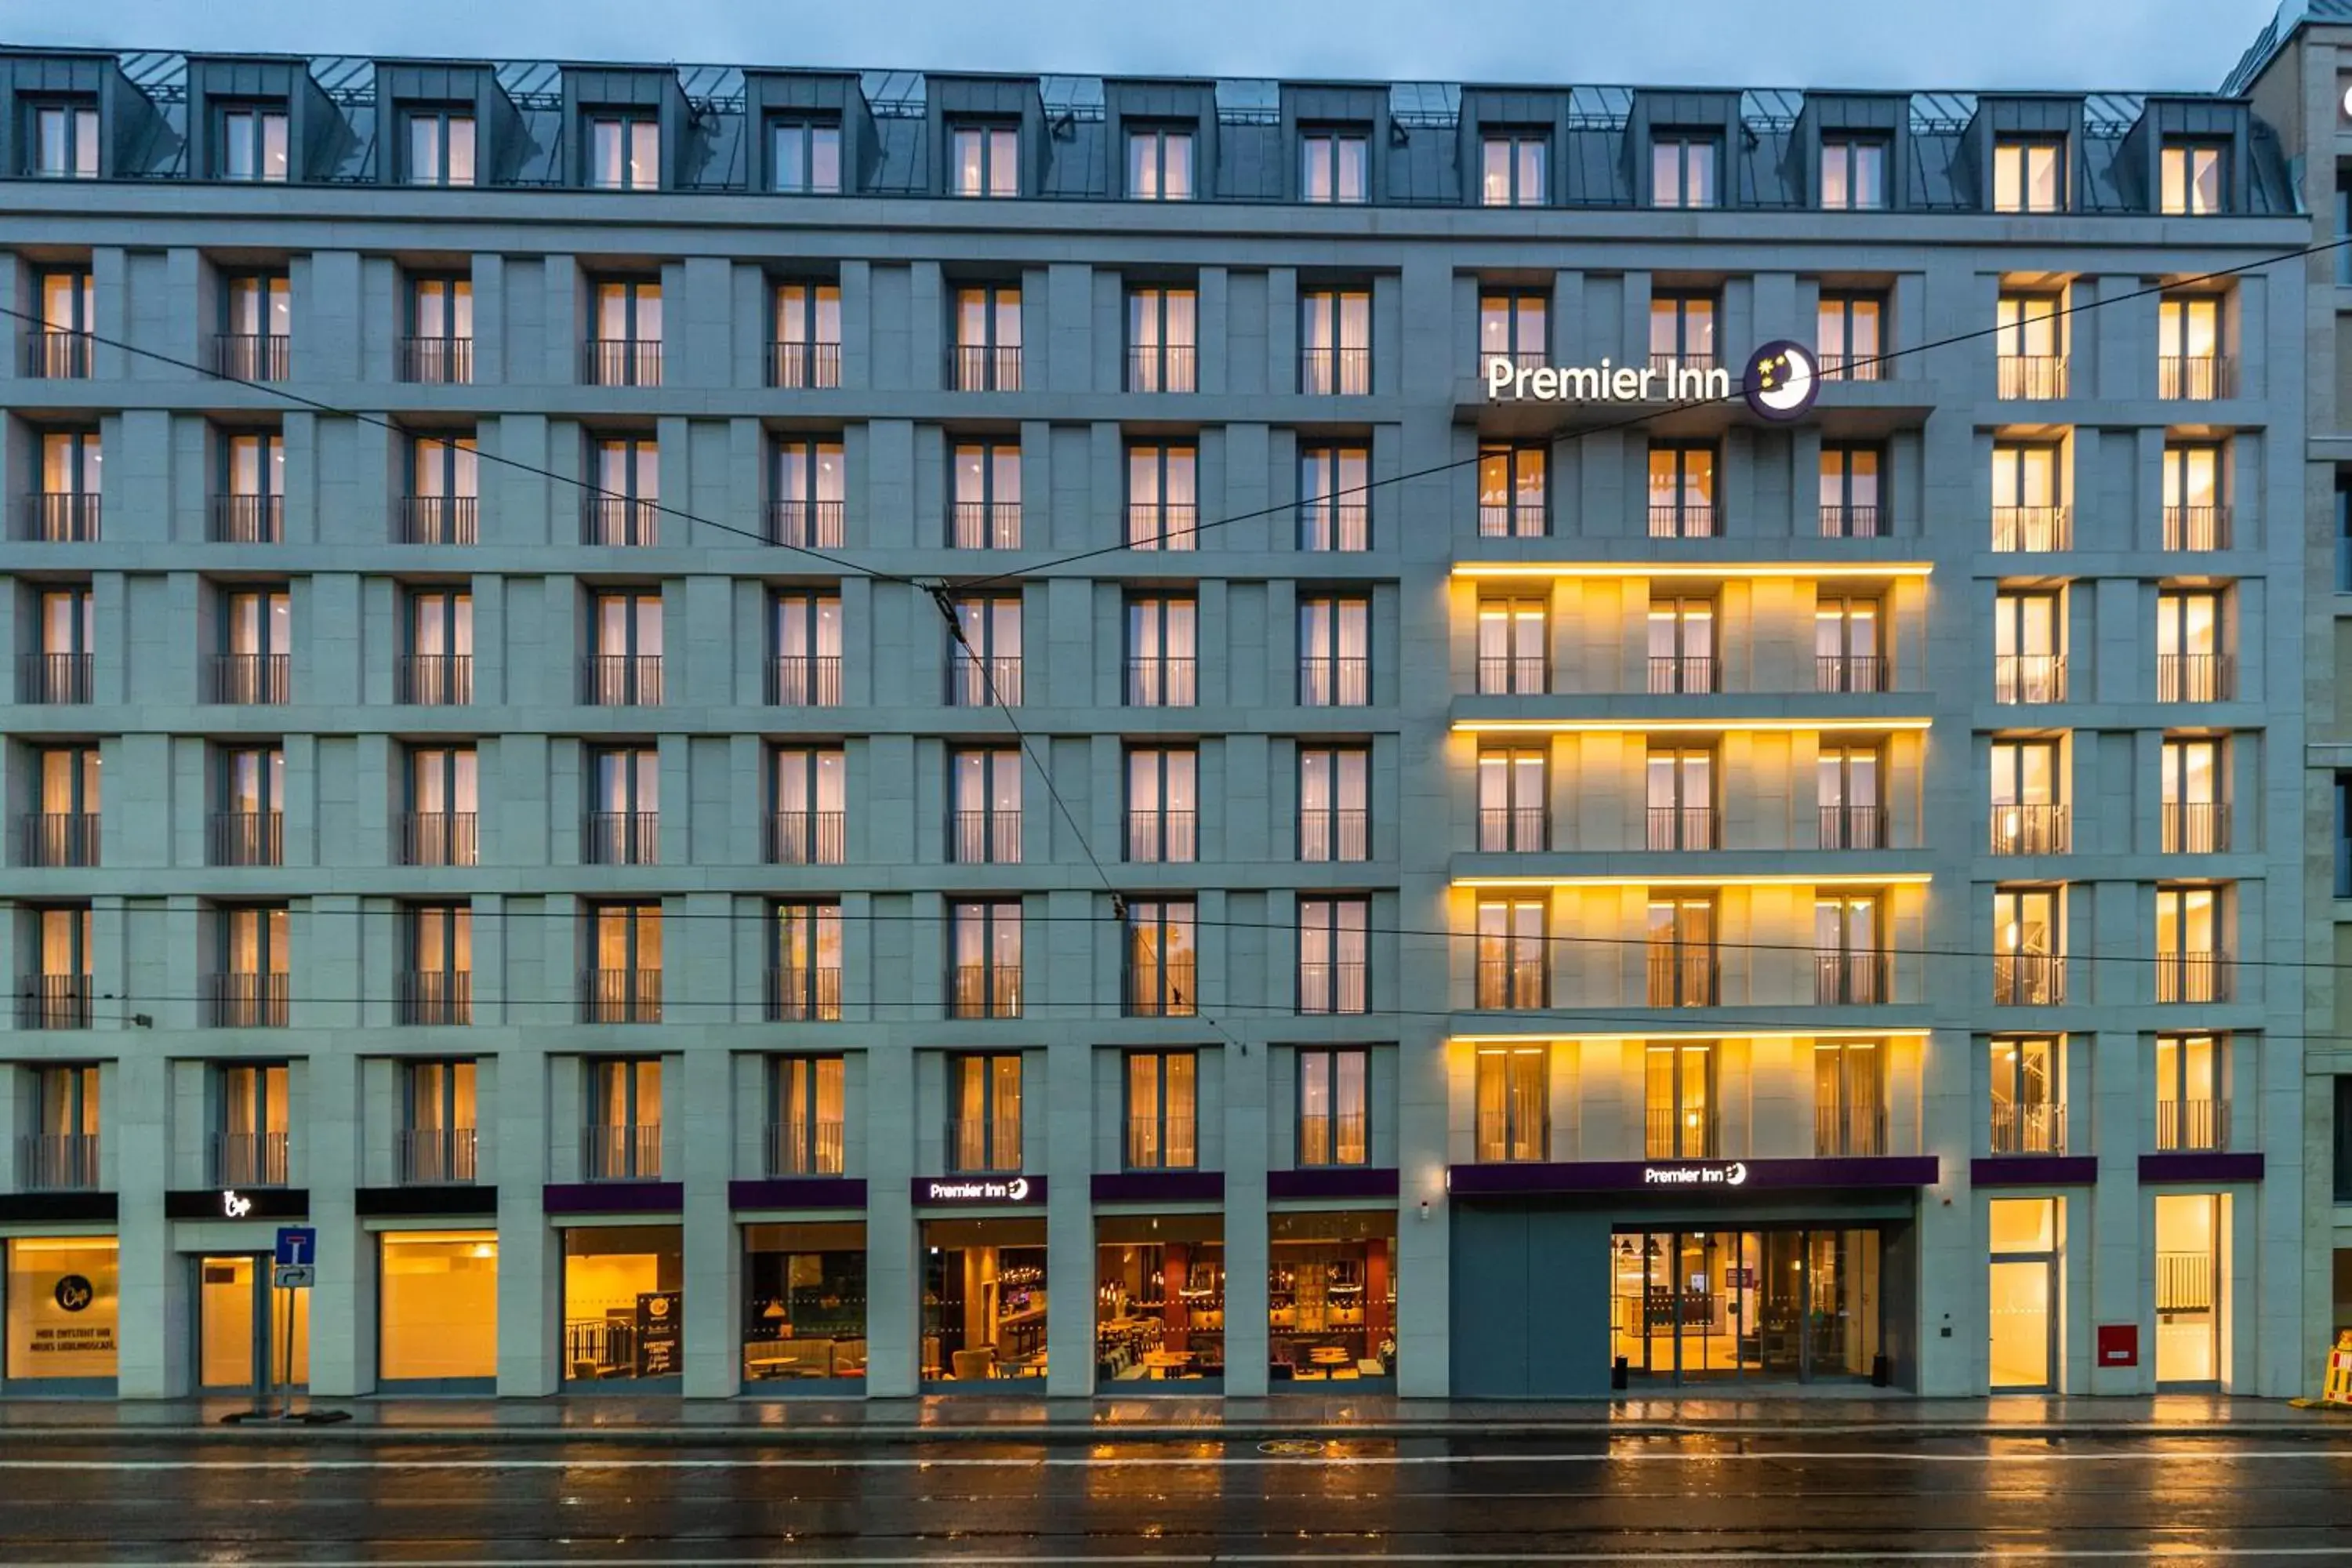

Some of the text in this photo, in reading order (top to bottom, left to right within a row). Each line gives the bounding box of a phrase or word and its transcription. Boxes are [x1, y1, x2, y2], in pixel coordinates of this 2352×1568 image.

[1488, 357, 1730, 400] Premier Inn
[1645, 1167, 1724, 1183] Premier Inn
[930, 1181, 1007, 1199] Premier Inn
